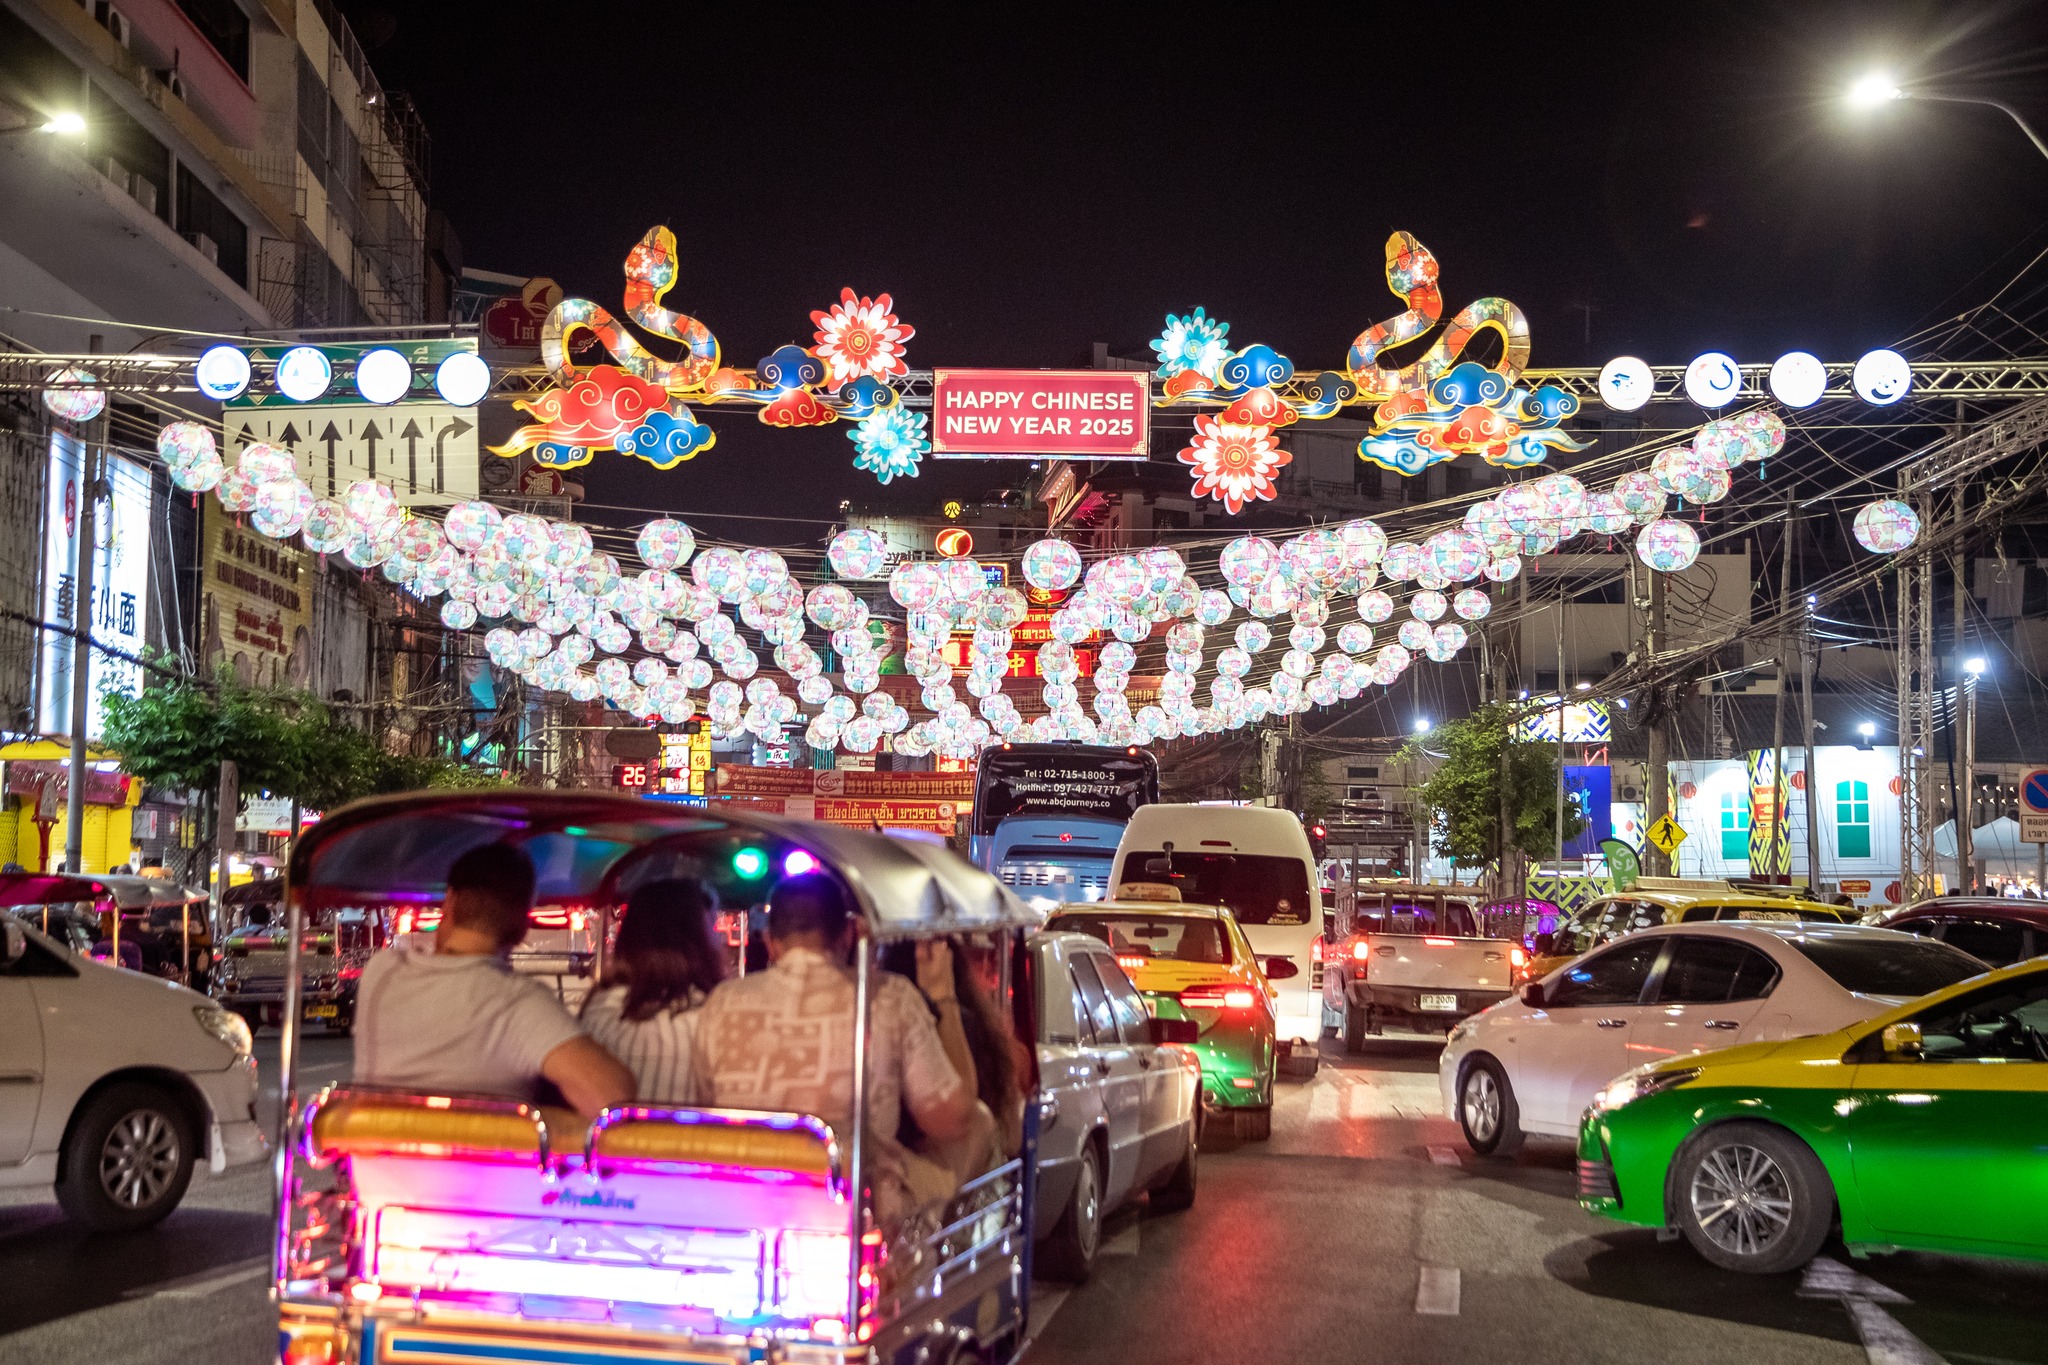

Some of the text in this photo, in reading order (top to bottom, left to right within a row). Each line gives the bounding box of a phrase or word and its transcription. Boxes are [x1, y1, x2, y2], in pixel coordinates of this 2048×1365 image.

[946, 391, 1134, 411] HAPPY CHINESE
[946, 416, 1133, 436] NEW YEAR 2025
[622, 766, 646, 786] 26
[1044, 769, 1115, 781] 02-715-1800-5
[1053, 783, 1121, 795] 097-427-7777
[1026, 797, 1110, 809] www.abcjourneys.co
